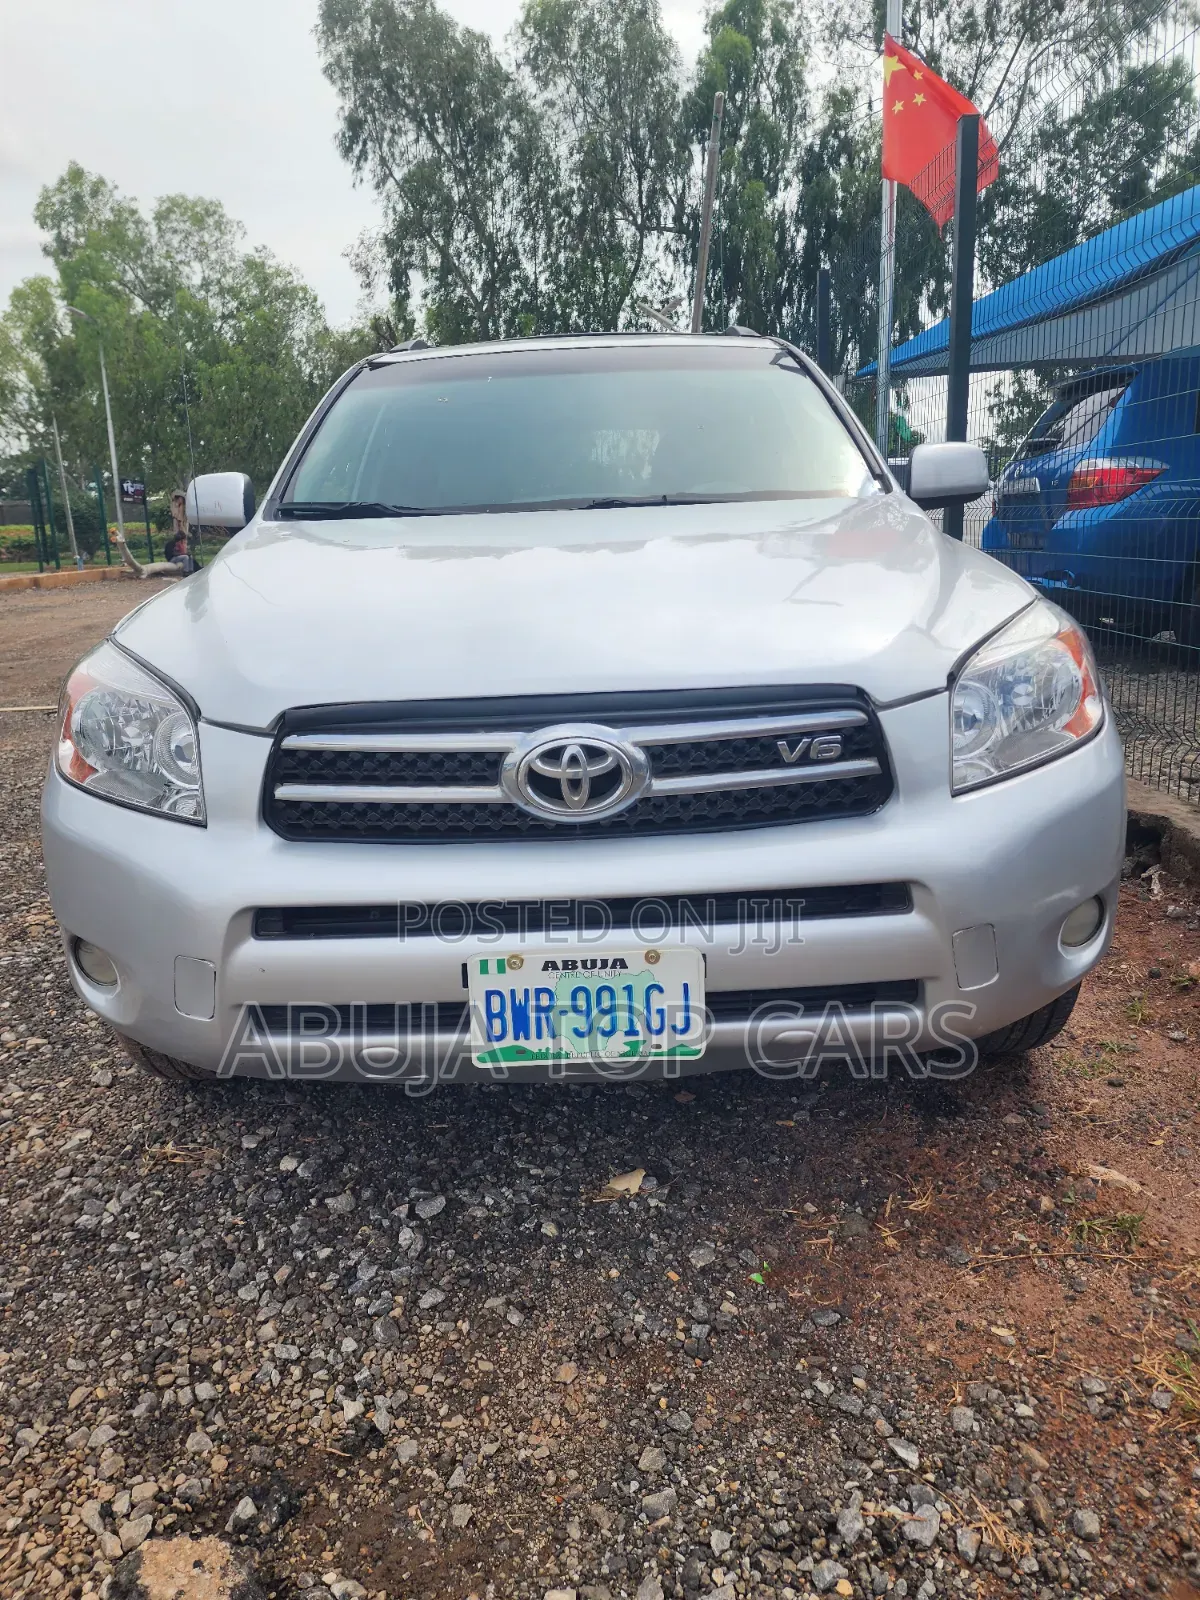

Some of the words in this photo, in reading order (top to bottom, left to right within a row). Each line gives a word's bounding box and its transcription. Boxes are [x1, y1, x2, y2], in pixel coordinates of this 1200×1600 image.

[777, 735, 842, 763] V6
[541, 957, 629, 971] ABUJA
[484, 982, 691, 1043] BWR-991GJ
